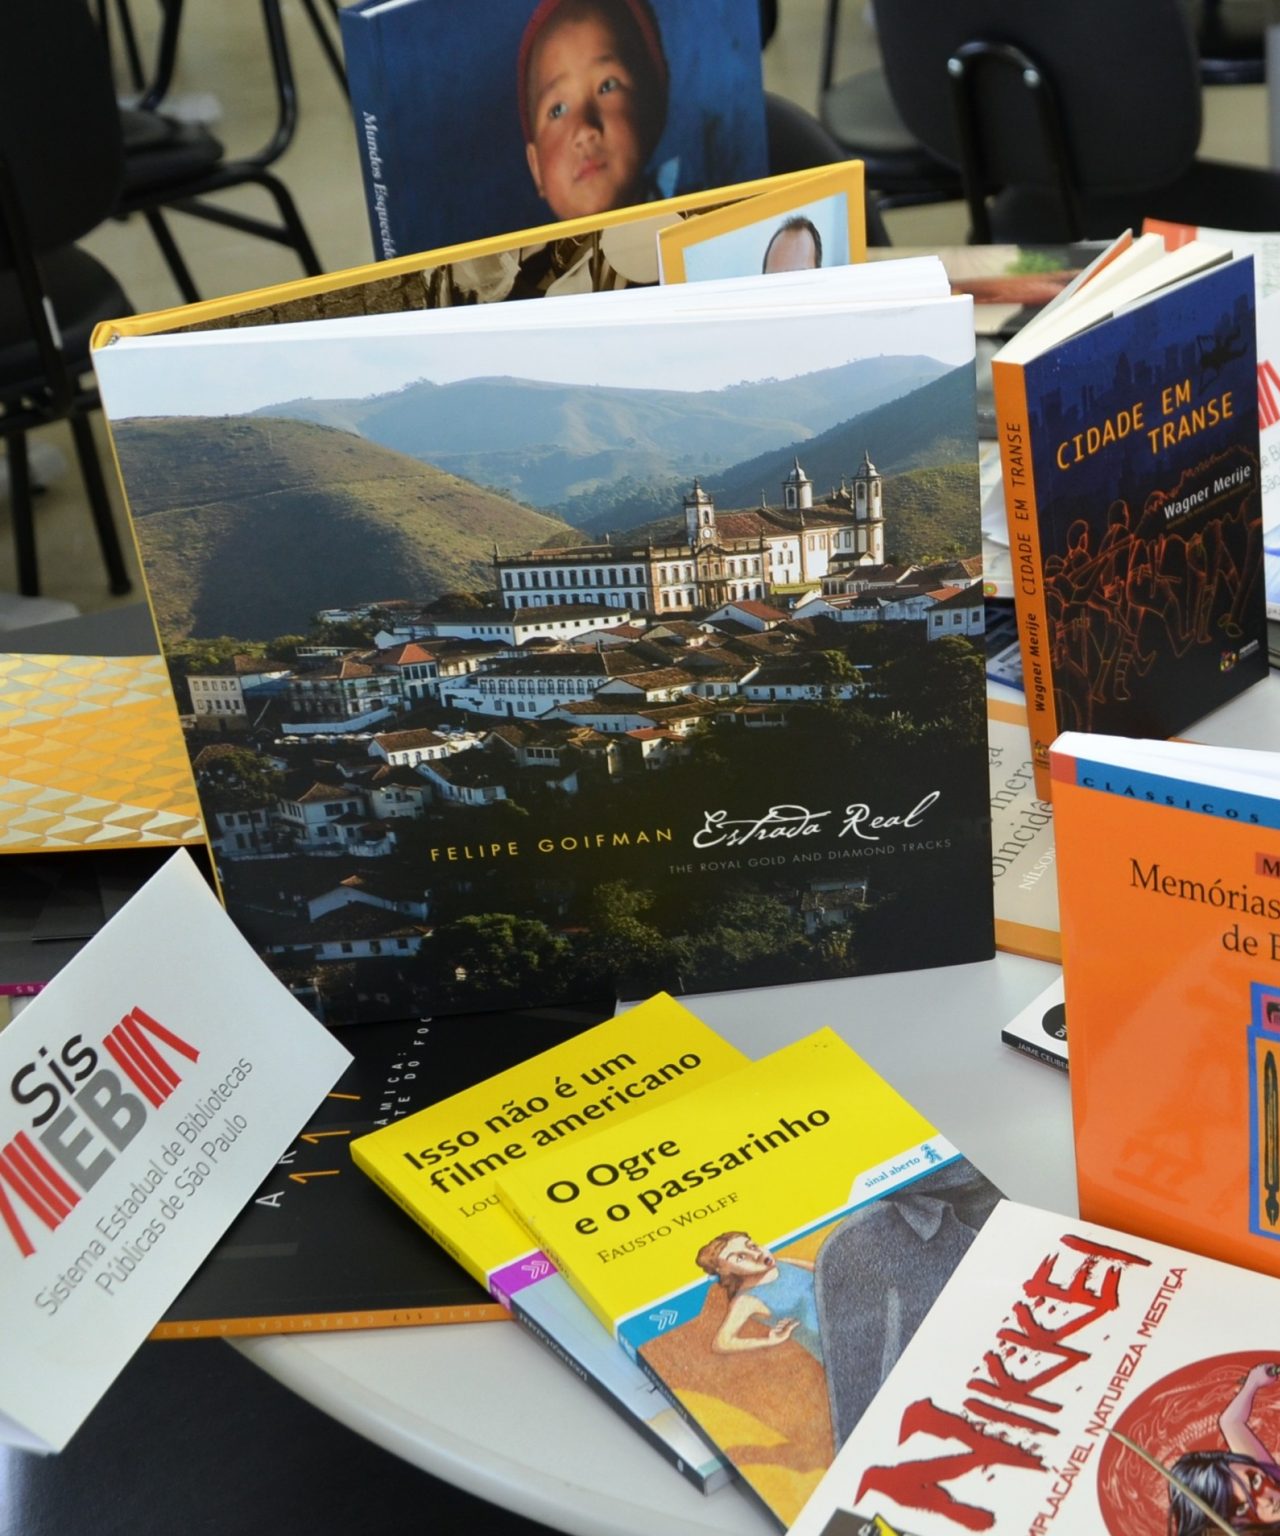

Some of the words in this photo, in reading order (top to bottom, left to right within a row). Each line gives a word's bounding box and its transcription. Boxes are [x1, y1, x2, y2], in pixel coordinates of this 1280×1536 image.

[363, 111, 383, 179] Mundos
[1011, 422, 1024, 488] TRANSE
[1056, 402, 1144, 470] CIDADE
[1162, 379, 1192, 415] EM
[1148, 392, 1233, 456] TRANSE
[1016, 498, 1030, 521] EM
[1164, 486, 1209, 519] Wagner
[1213, 466, 1251, 494] Merije
[1023, 533, 1037, 596] CIDADE
[1030, 612, 1042, 653] Merije
[1035, 660, 1047, 713] Wagner
[692, 804, 832, 849] Estrada
[838, 790, 942, 840] Real
[1083, 775, 1260, 824] CLÁSSICOS
[430, 841, 520, 862] FELIPE
[538, 828, 675, 853] GOIFMAN
[668, 863, 694, 875] THE
[700, 858, 742, 872] ROYAL
[747, 854, 787, 868] GOLD
[792, 851, 823, 864] AND
[828, 845, 896, 860] DIAMOND
[900, 838, 952, 854] TRACKS
[1222, 924, 1258, 956] de
[10, 1033, 99, 1128] Sis
[1018, 1042, 1039, 1058] JAIME
[402, 1129, 480, 1171] Isso
[484, 1099, 550, 1137] não
[554, 1076, 576, 1100] é
[580, 1047, 638, 1086] um
[430, 1142, 526, 1195] filme
[530, 1051, 702, 1150] americano
[34, 1235, 107, 1317] Sistema
[95, 1159, 165, 1241] Estadual
[161, 1139, 186, 1166] de
[176, 1056, 253, 1146] Bibliotecas
[546, 1179, 581, 1205] O
[586, 1137, 682, 1193] Ogre
[574, 1214, 600, 1237] e
[604, 1199, 632, 1225] o
[637, 1106, 831, 1215] passarinho
[863, 1172, 888, 1190] sinal
[887, 1155, 922, 1181] aberto
[95, 1219, 166, 1296] Públicas
[161, 1192, 185, 1221] de
[182, 1159, 210, 1196] São
[208, 1112, 248, 1164] Paulo
[596, 1223, 672, 1264] FAUSTO
[672, 1192, 741, 1231] WOLFF
[853, 1233, 1160, 1532] NIKKEI
[1084, 1344, 1147, 1437] NATUREZA
[1137, 1266, 1188, 1338] MESTIÇA
